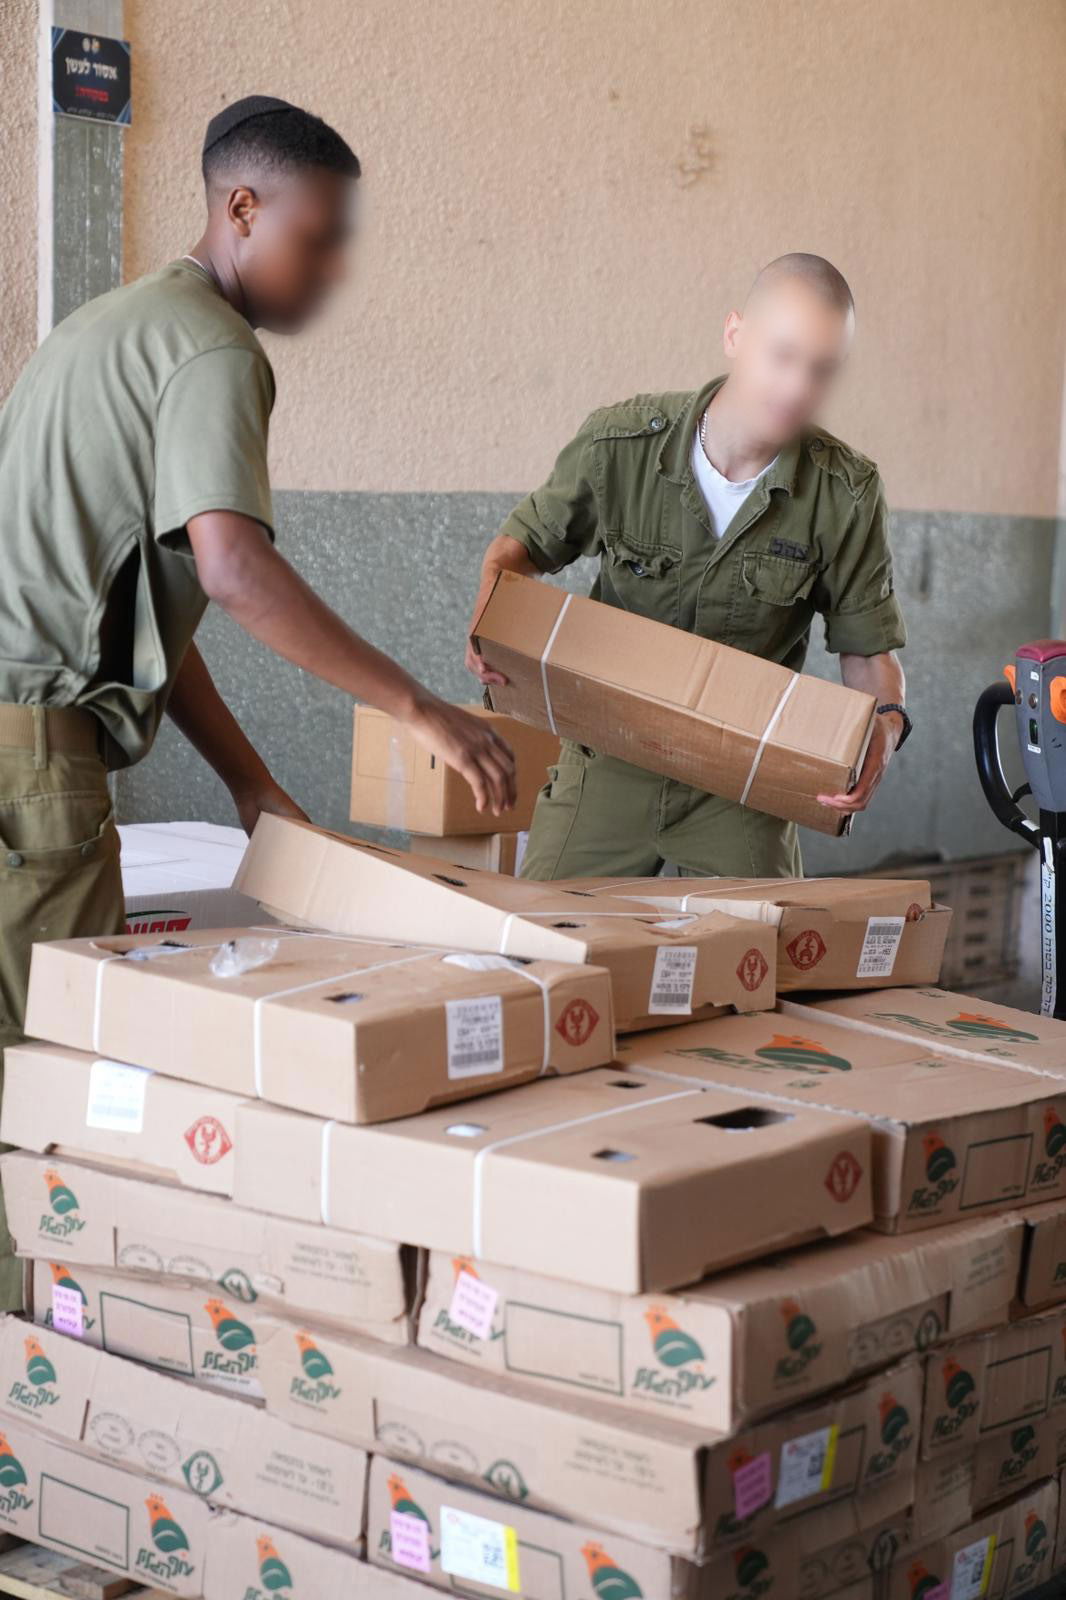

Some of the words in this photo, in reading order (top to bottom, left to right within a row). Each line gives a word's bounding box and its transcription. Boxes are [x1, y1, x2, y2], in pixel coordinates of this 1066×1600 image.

[64, 56, 91, 76] לעשן
[92, 62, 119, 80] אסור
[1044, 892, 1053, 933] 2000
[1043, 975, 1053, 1013] הרמה
